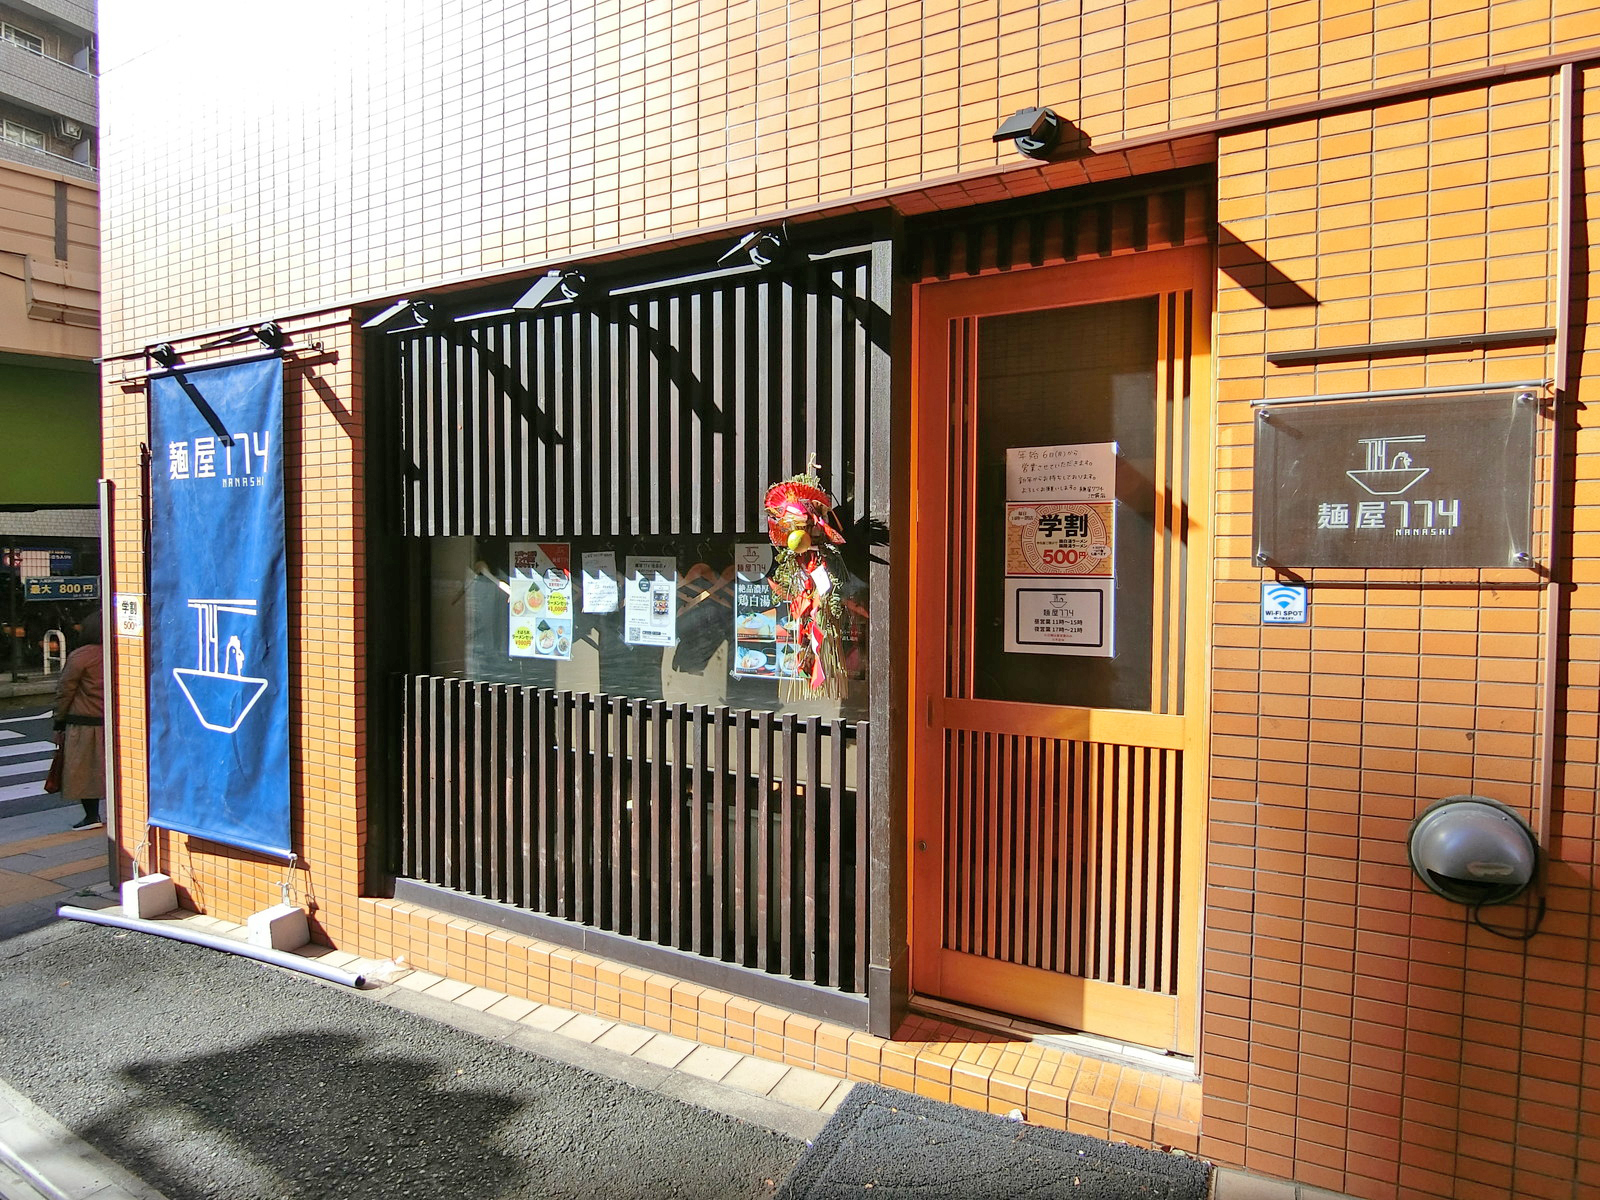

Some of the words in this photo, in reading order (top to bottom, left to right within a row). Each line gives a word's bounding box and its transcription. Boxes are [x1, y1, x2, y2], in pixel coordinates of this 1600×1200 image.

[222, 476, 264, 488] NANASHI
[1038, 513, 1088, 537] 学割
[1396, 528, 1452, 536] NANASHI
[1043, 549, 1088, 565] 500円
[59, 584, 81, 594] 800
[738, 584, 770, 594] 絶品濃厚
